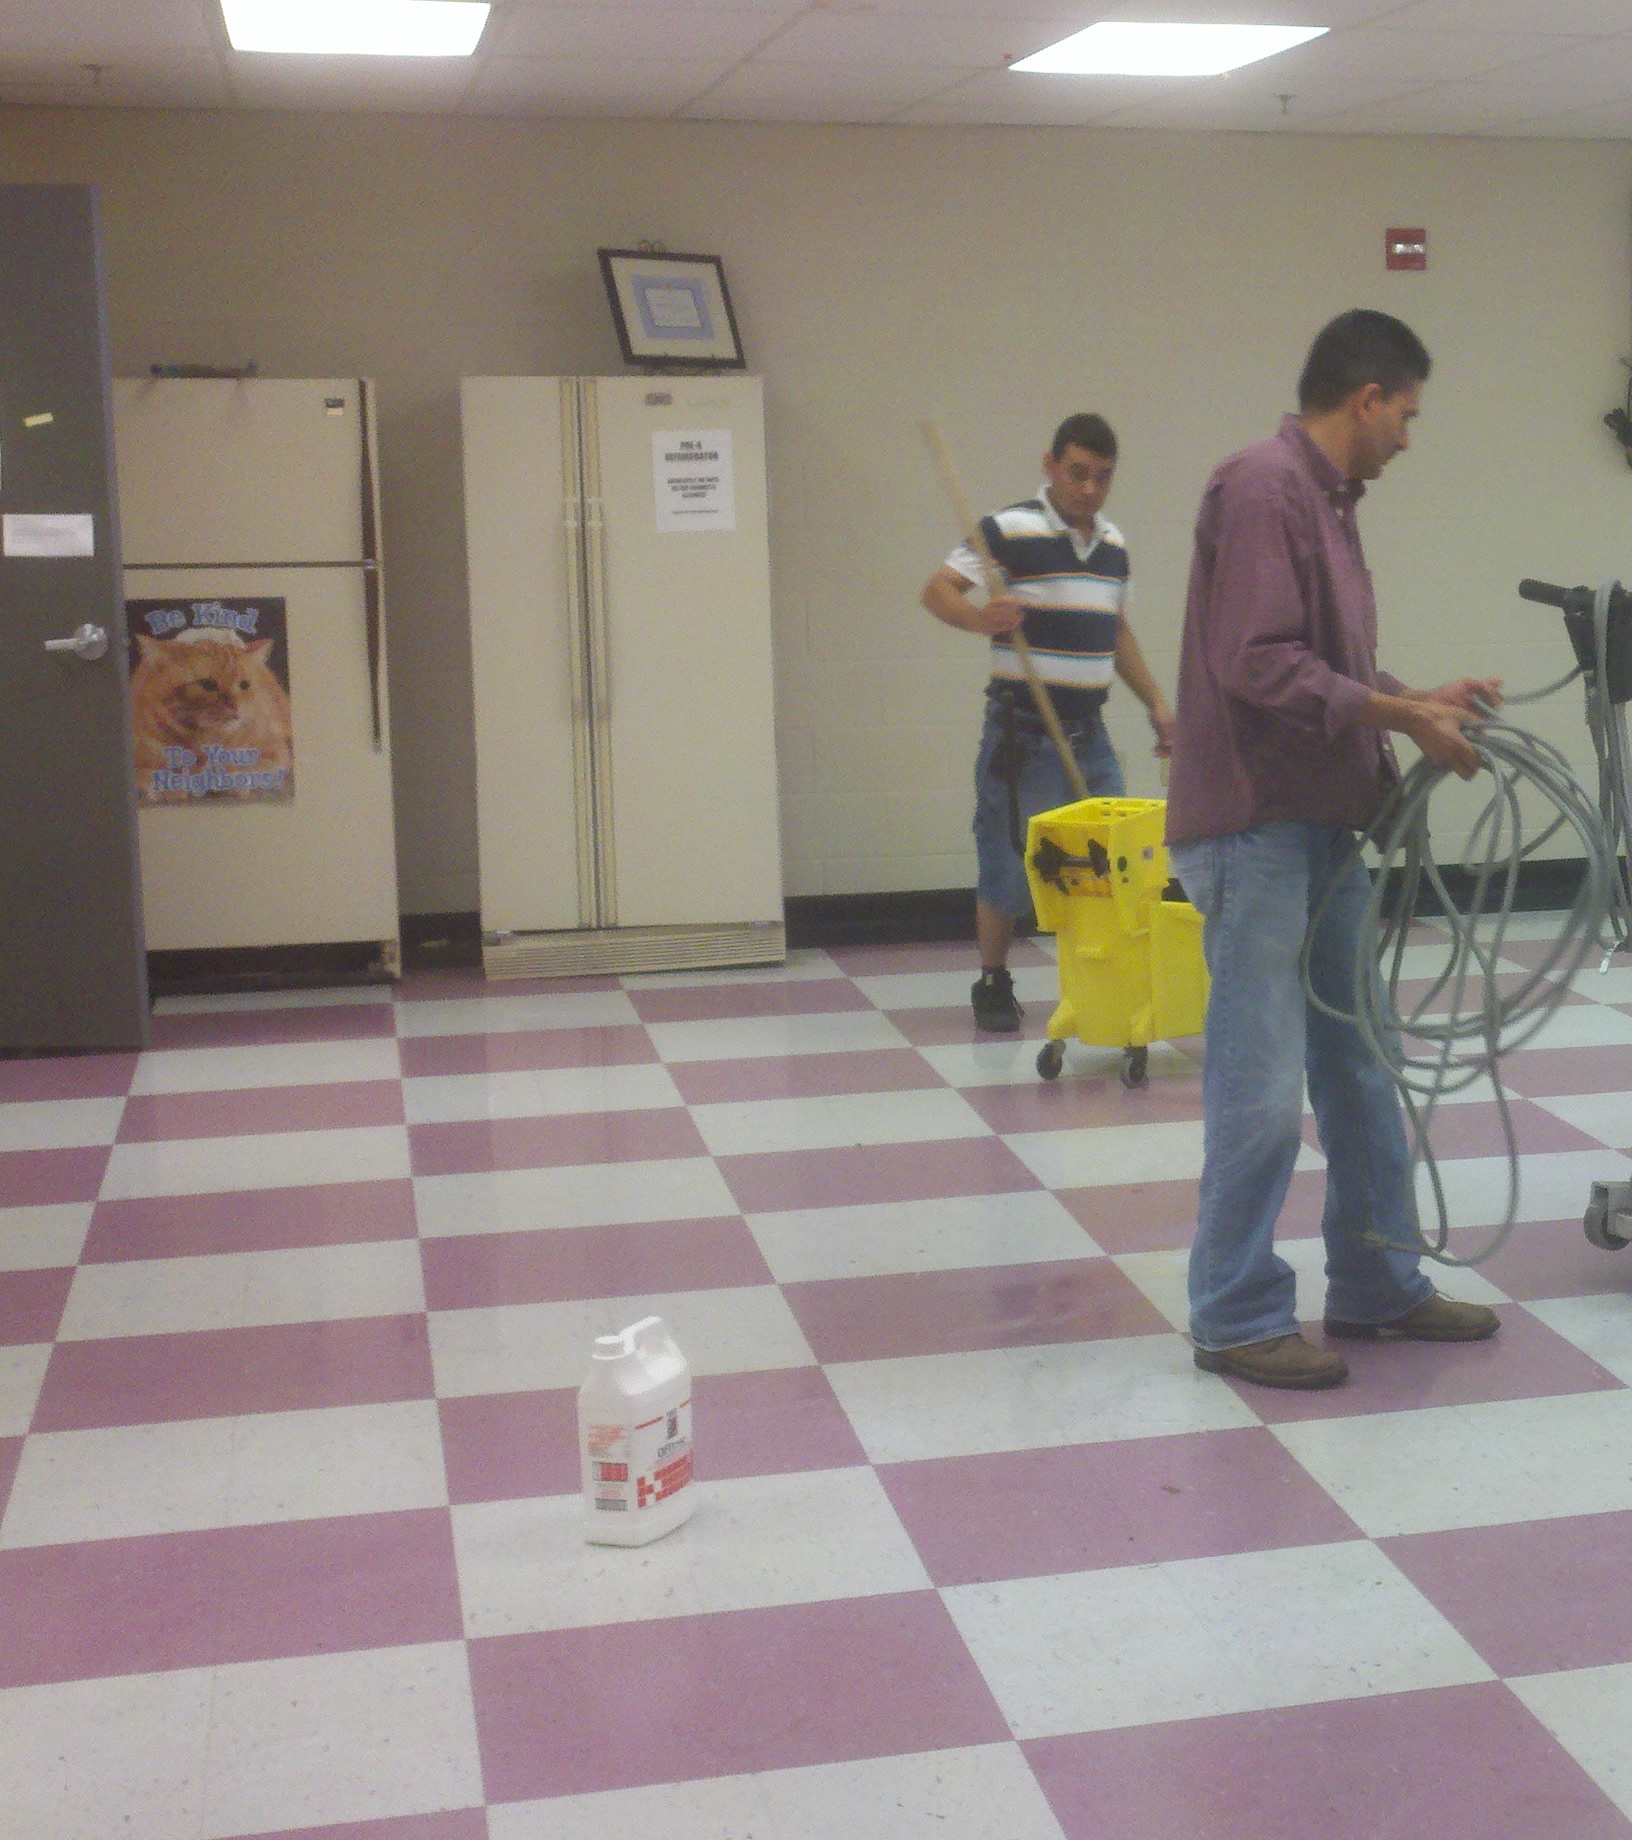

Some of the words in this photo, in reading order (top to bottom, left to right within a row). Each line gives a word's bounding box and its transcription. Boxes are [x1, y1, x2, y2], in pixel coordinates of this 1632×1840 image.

[145, 609, 188, 635] Be
[192, 601, 260, 634] Kind
[163, 745, 199, 769] To
[203, 744, 262, 767] Your
